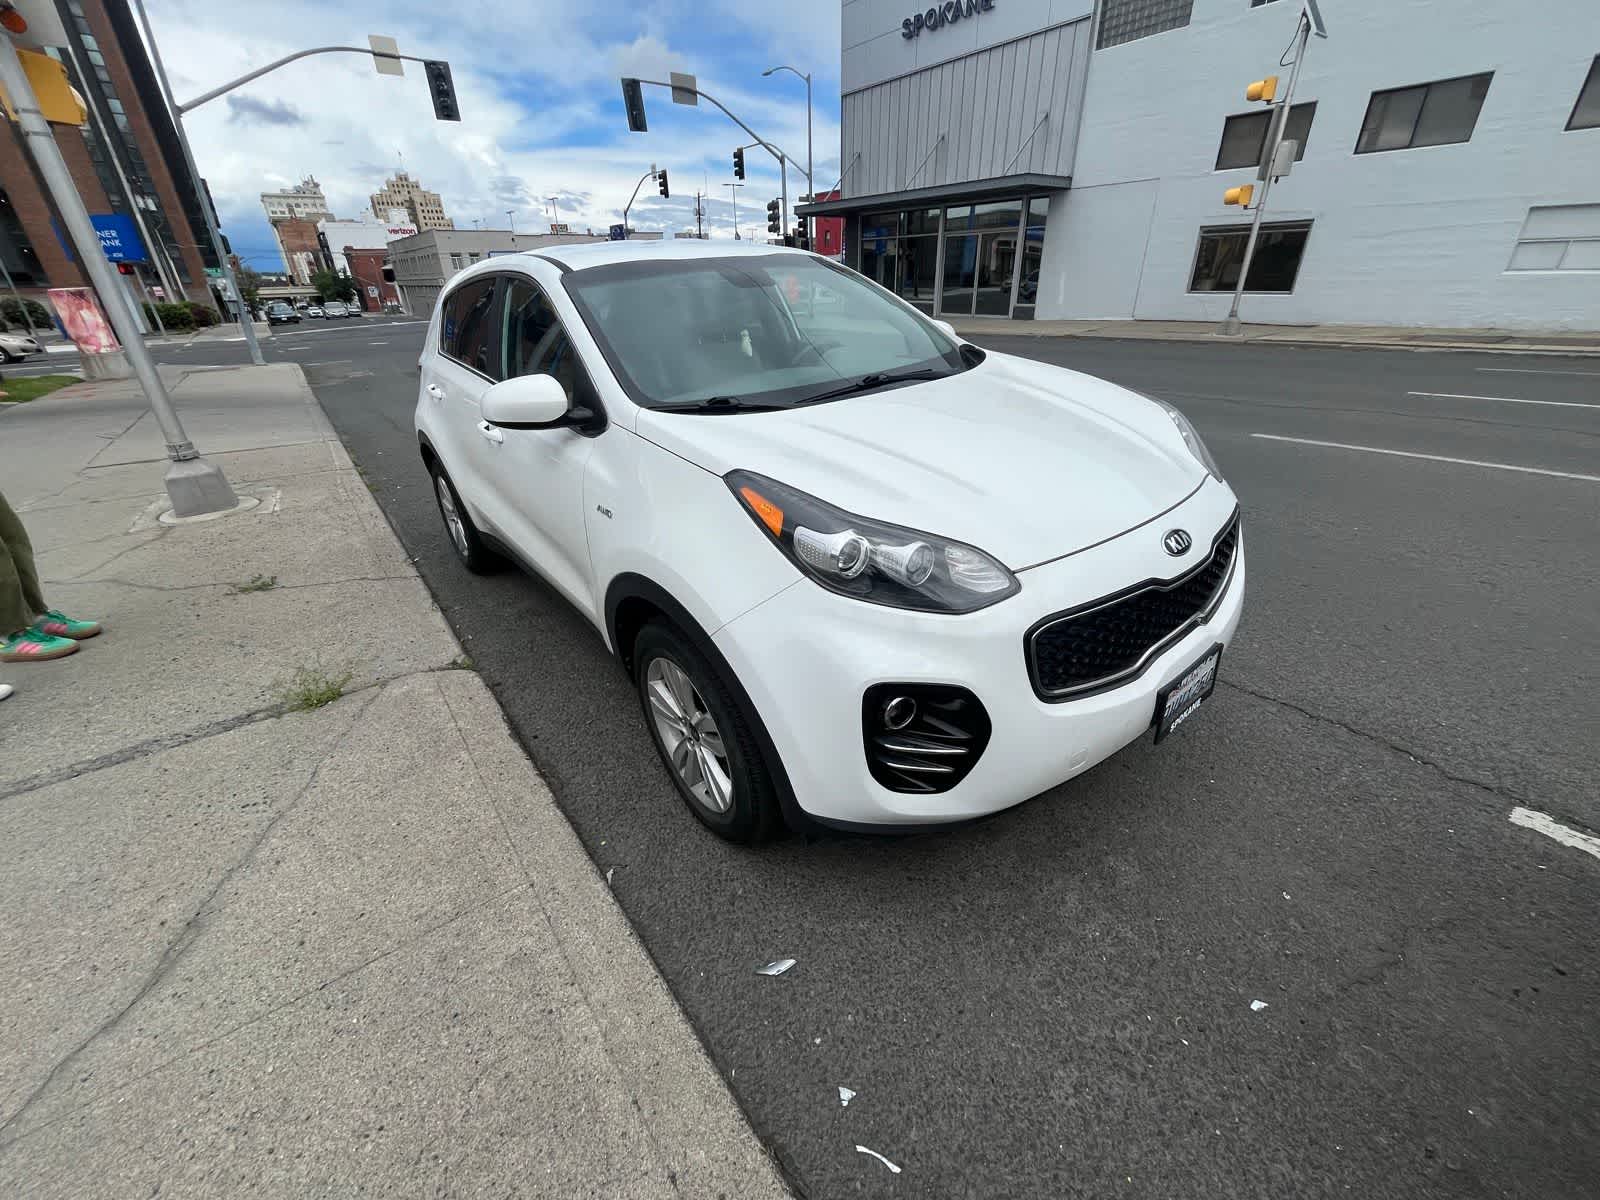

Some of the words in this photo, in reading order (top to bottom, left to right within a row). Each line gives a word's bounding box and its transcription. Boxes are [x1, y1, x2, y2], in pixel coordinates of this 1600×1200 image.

[902, 0, 995, 40] SPOKANE
[96, 230, 119, 239] NER
[388, 227, 416, 235] verizon
[100, 239, 122, 247] ANK
